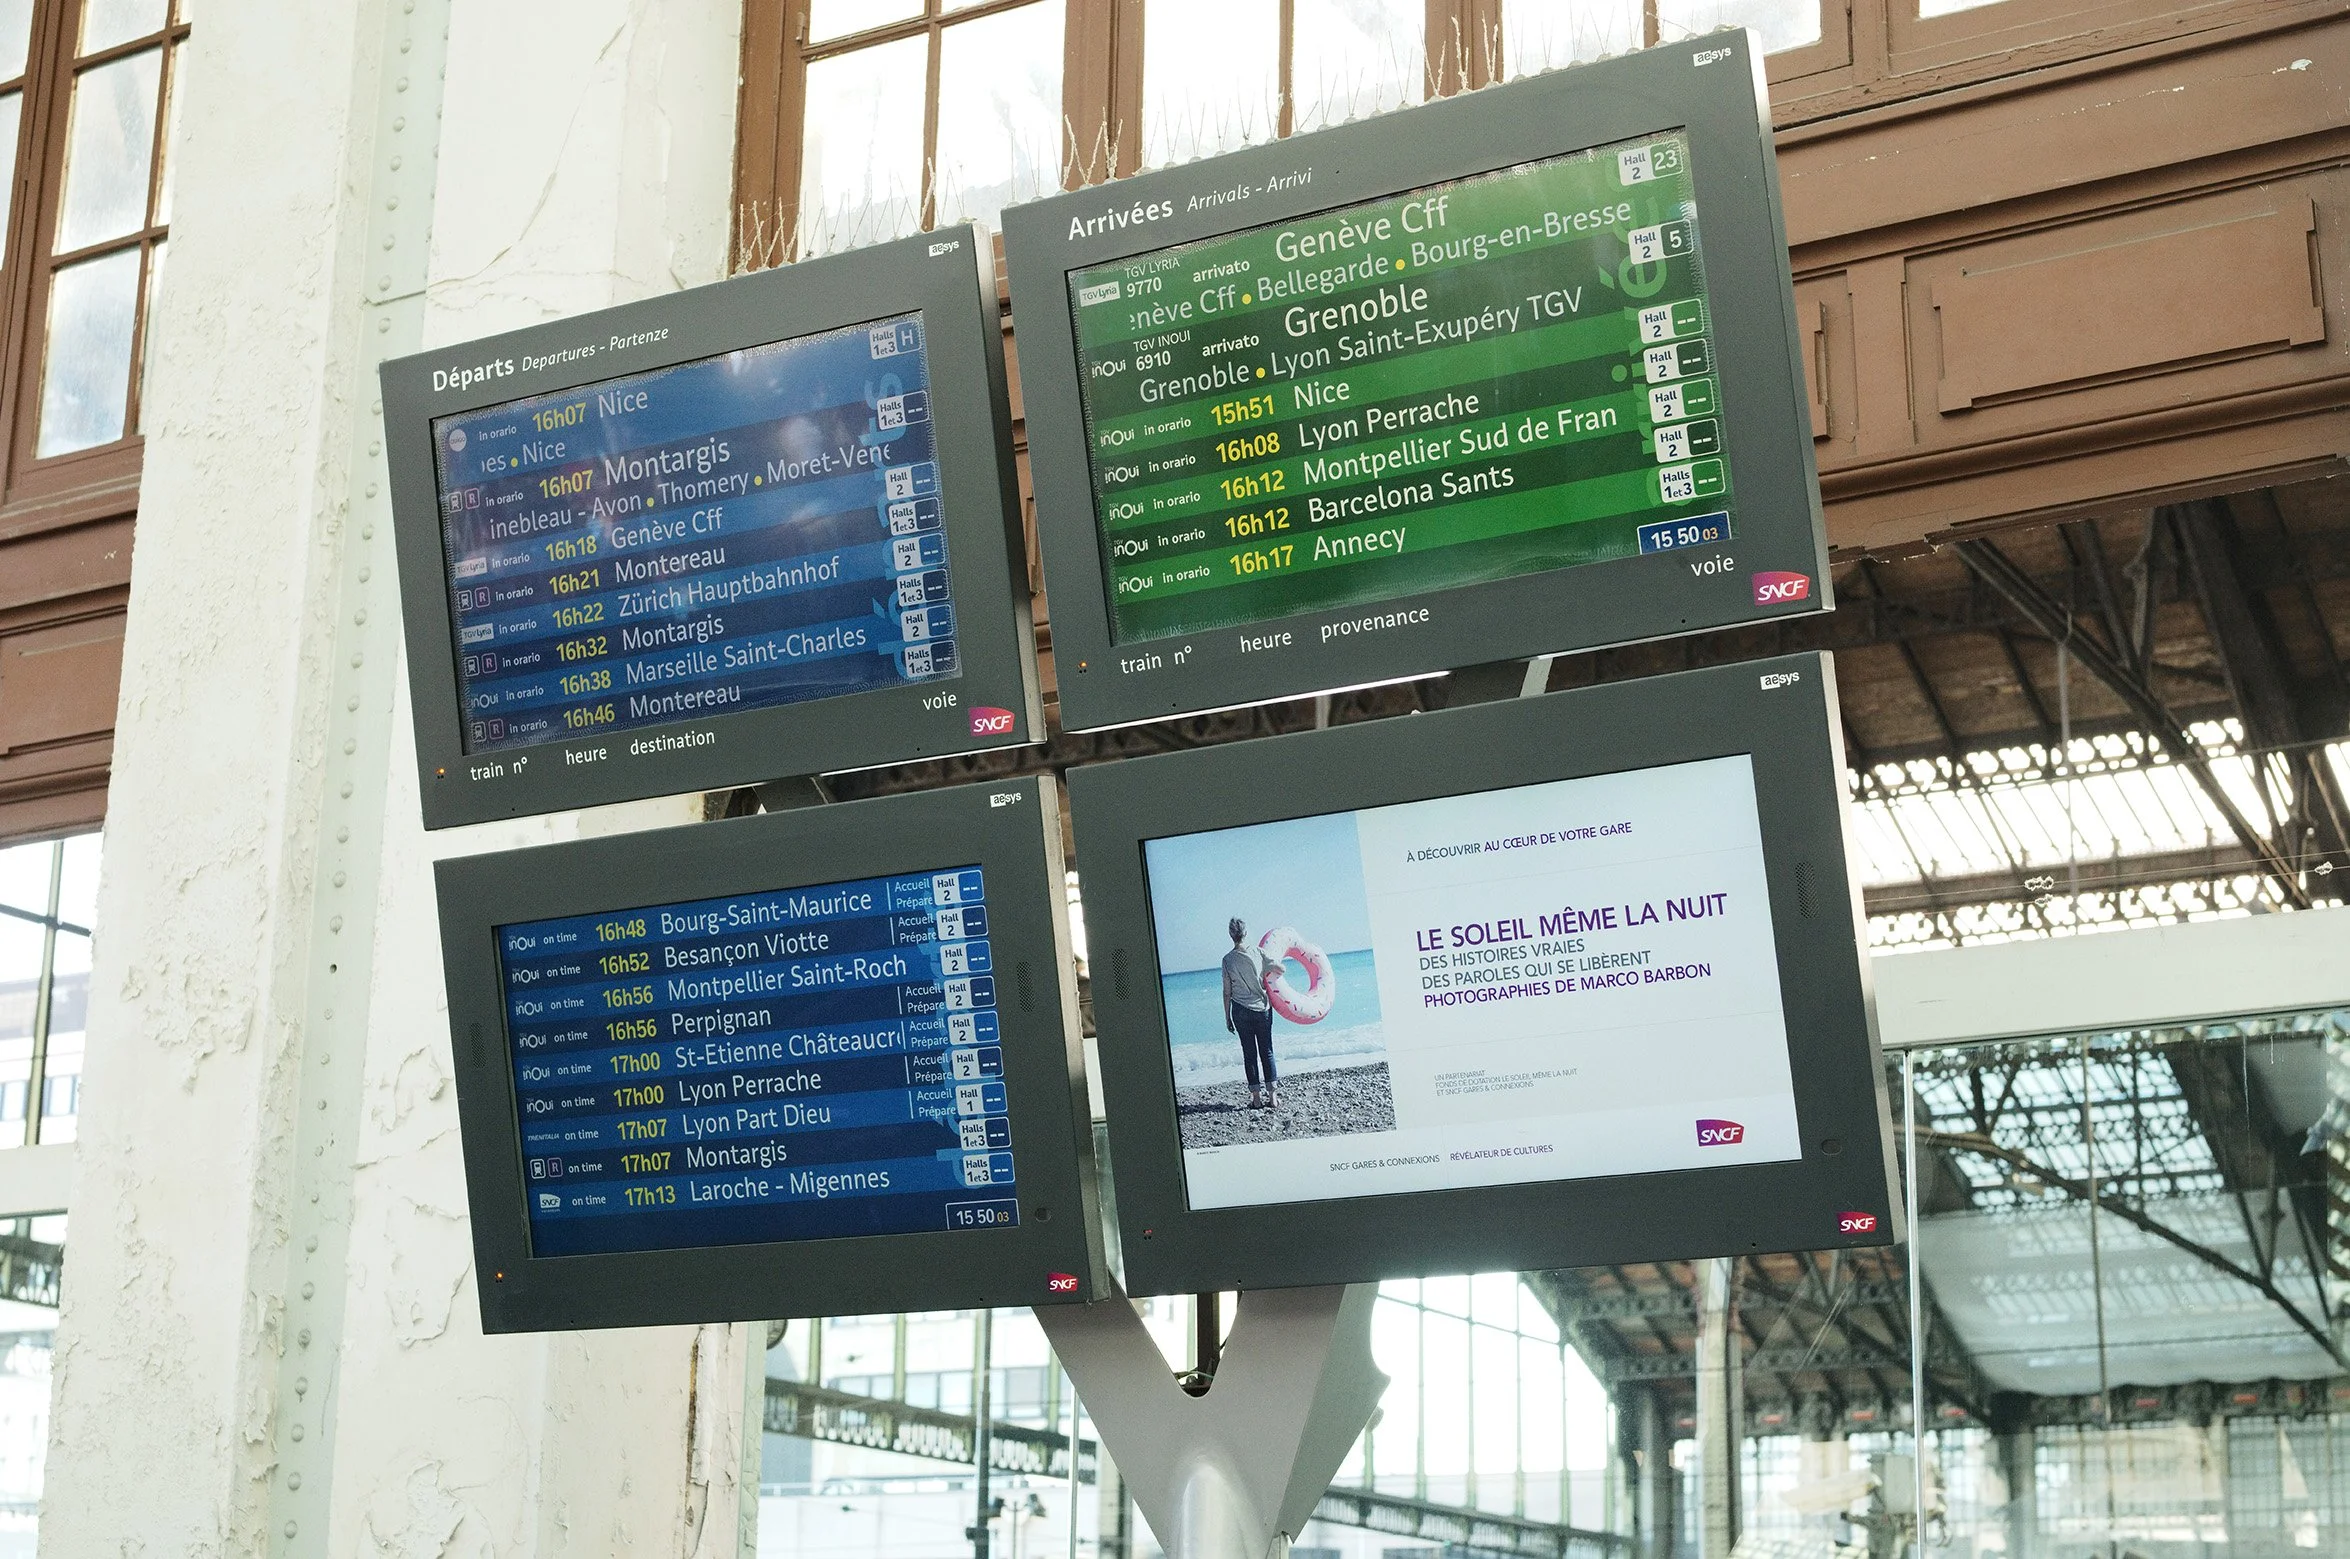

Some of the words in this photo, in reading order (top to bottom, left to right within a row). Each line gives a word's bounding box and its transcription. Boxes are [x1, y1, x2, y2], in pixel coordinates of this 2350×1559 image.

[1695, 46, 1732, 65] aesys
[1624, 153, 1646, 166] Hall
[1654, 150, 1678, 172] 23
[1187, 184, 1250, 212] Arrivals
[1267, 167, 1313, 192] Arrivi
[1068, 200, 1174, 241] Arrivées
[930, 240, 960, 256] aesys
[1127, 277, 1162, 298] 9770
[1193, 260, 1250, 283] arrivato
[1275, 218, 1391, 262] Genève
[1401, 195, 1449, 233] Cff
[1633, 231, 1657, 246] Hall
[1670, 230, 1682, 248] 5
[1124, 265, 1147, 279] TGV
[1149, 257, 1180, 276] LYRIA
[1200, 284, 1235, 314] Cff
[1257, 254, 1389, 301] Bellegarde
[1411, 202, 1631, 267] Bourg-en-Bresse
[901, 328, 913, 347] H
[1133, 337, 1156, 353] TGV
[1158, 330, 1191, 348] INOUI
[1135, 350, 1171, 371] 6910
[1202, 333, 1260, 357] arrivato
[1284, 284, 1428, 337] Grenoble
[1140, 361, 1250, 403] Grenoble
[1271, 346, 1331, 380] Lyon
[1339, 304, 1520, 361] Saint-Exupéry
[1527, 286, 1582, 321] TGV
[522, 344, 596, 372] Departures
[609, 328, 669, 351] Partenze
[433, 357, 515, 392] Départs
[532, 402, 587, 432] 16h07
[598, 390, 648, 418] Nice
[1211, 395, 1275, 426] 15h51
[1294, 381, 1350, 410] Nice
[1215, 432, 1281, 463] 16h08
[1298, 418, 1358, 451] Lyon
[1366, 393, 1480, 434] Perrache
[522, 440, 566, 465] Nice
[539, 469, 594, 499] 16h07
[604, 437, 731, 486] Montargis
[1220, 469, 1285, 501] 16h12
[1303, 437, 1452, 485] Montpellier
[1459, 422, 1509, 455] Sud
[1517, 417, 1549, 444] de
[1557, 406, 1618, 436] Fran
[490, 508, 572, 540] inebleau
[592, 495, 641, 520] Avon
[657, 472, 749, 505] Thomery
[1224, 507, 1290, 538] 16h12
[1308, 482, 1434, 523] Barcelona
[1441, 466, 1515, 498] Sants
[546, 535, 597, 562] 16h18
[611, 520, 686, 549] Genève
[692, 507, 723, 532] Cff
[1650, 530, 1673, 550] 15
[1677, 525, 1700, 545] 50
[1702, 527, 1718, 541] 03
[549, 569, 600, 595] 16h21
[615, 547, 726, 583] Montereau
[1162, 572, 1174, 584] in
[1176, 565, 1211, 582] orario
[1229, 544, 1294, 576] 16h17
[1313, 527, 1407, 561] Annecy
[1690, 554, 1734, 577] voie
[553, 602, 604, 629] 16h22
[618, 587, 681, 617] Zürich
[688, 555, 840, 603] Hauptbahnhof
[1757, 579, 1806, 601] SNCF
[556, 636, 608, 662] 16h32
[622, 613, 724, 651] Montargis
[1240, 631, 1292, 653] heure
[1320, 607, 1430, 643] provenance
[560, 670, 611, 695] 16h38
[626, 650, 718, 685] Marseille
[723, 627, 867, 669] Saint-Charles
[1121, 652, 1162, 674] train
[1174, 645, 1192, 664] n°
[1763, 671, 1800, 687] aesys
[563, 703, 616, 729] 16h46
[629, 684, 741, 719] Montereau
[922, 691, 957, 711] voie
[973, 716, 1011, 733] SNCF
[565, 747, 607, 766] heure
[630, 729, 715, 756] destination
[470, 762, 504, 781] train
[513, 757, 528, 775] n°
[991, 791, 1022, 806] aesys
[1406, 851, 1415, 863] À
[1417, 842, 1481, 862] DÉCOUVRIR
[1484, 840, 1500, 853] AU
[1540, 833, 1556, 845] DE
[1559, 827, 1597, 843] VOTRE
[1599, 822, 1632, 837] GARE
[894, 879, 930, 893] Accueil
[896, 895, 933, 909] Prépare
[543, 935, 554, 945] on
[557, 931, 577, 943] time
[596, 918, 647, 942] 16h48
[661, 890, 872, 935] Bourg-Saint-Maurice
[1416, 928, 1444, 952] LE
[1450, 919, 1533, 948] SOLEIL
[1539, 906, 1618, 937] MÊME
[1625, 902, 1659, 927] LA
[1666, 893, 1727, 922] NUIT
[599, 952, 650, 975] 16h52
[664, 941, 759, 968] Besançon
[764, 931, 829, 956] Viotte
[1419, 955, 1448, 971] DES
[1452, 946, 1527, 968] HISTOIRES
[1531, 938, 1585, 959] VRAIES
[1421, 974, 1450, 990] DES
[1454, 967, 1520, 987] PAROLES
[1524, 961, 1553, 980] QUI
[1558, 958, 1576, 975] SE
[1579, 950, 1651, 972] LIBÈRENT
[603, 985, 654, 1008] 16h56
[667, 969, 785, 1002] Montpellier
[791, 953, 907, 988] Saint-Roch
[1424, 981, 1551, 1009] PHOTOGRAPHIES
[1555, 978, 1577, 994] DE
[1580, 971, 1639, 992] MARCO
[1644, 963, 1712, 984] BARBON
[606, 1018, 657, 1042] 16h56
[671, 1008, 772, 1038] Perpignan
[610, 1051, 661, 1074] 17h00
[675, 1041, 782, 1068] St-Etienne
[613, 1084, 665, 1108] 17h00
[678, 1076, 726, 1102] Lyon
[732, 1069, 822, 1097] Perrache
[617, 1118, 667, 1141] 17h07
[682, 1113, 730, 1140] Lyon
[736, 1107, 778, 1130] Part
[784, 1102, 831, 1127] Dieu
[1700, 1126, 1741, 1144] SNCF
[621, 1151, 671, 1174] 17h07
[686, 1140, 787, 1168] Montargis
[1450, 1148, 1499, 1162] RÉVÉLATEUR
[1501, 1147, 1512, 1157] DE
[1514, 1144, 1553, 1156] CULTURES
[625, 1185, 676, 1206] 17h13
[689, 1176, 769, 1202] Laroche
[790, 1170, 890, 1199] Migennes
[956, 1211, 973, 1225] 15
[977, 1208, 995, 1224] 50
[997, 1211, 1010, 1222] 03
[1840, 1216, 1875, 1232] SNCF
[1049, 1277, 1077, 1290] SNCF
